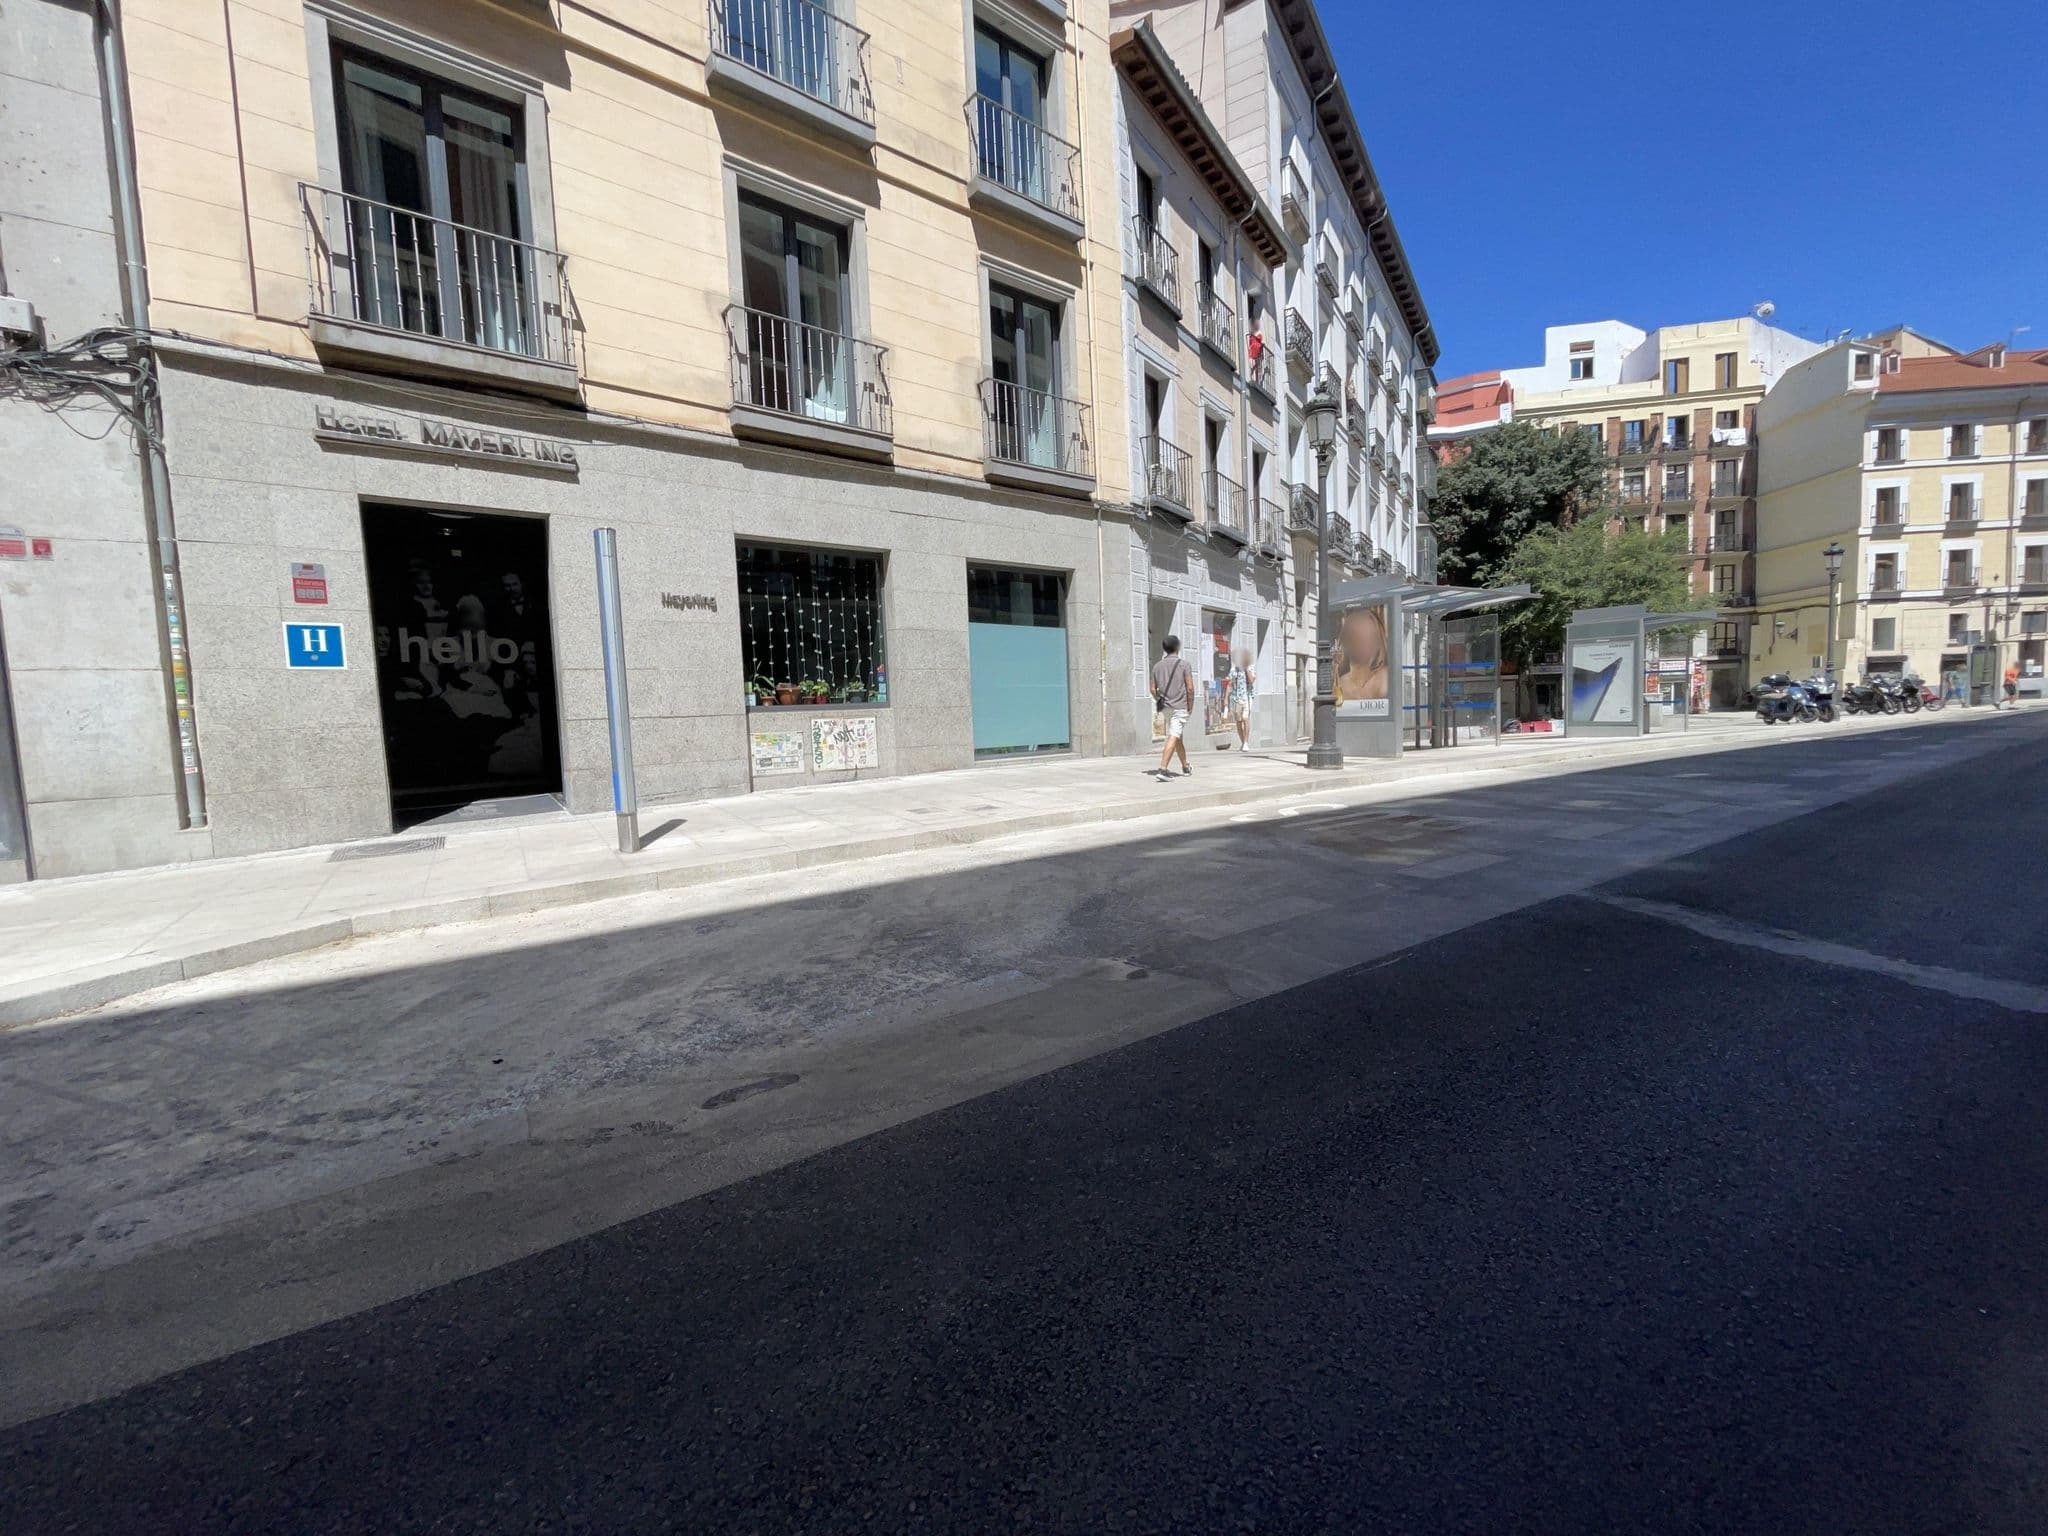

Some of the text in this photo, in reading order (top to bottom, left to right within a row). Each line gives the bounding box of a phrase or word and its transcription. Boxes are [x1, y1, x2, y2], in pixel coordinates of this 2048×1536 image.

[315, 404, 577, 462] HOTEL MAYERLING
[302, 628, 328, 652] H
[398, 627, 519, 664] hello
[1360, 700, 1385, 710] DIOR
